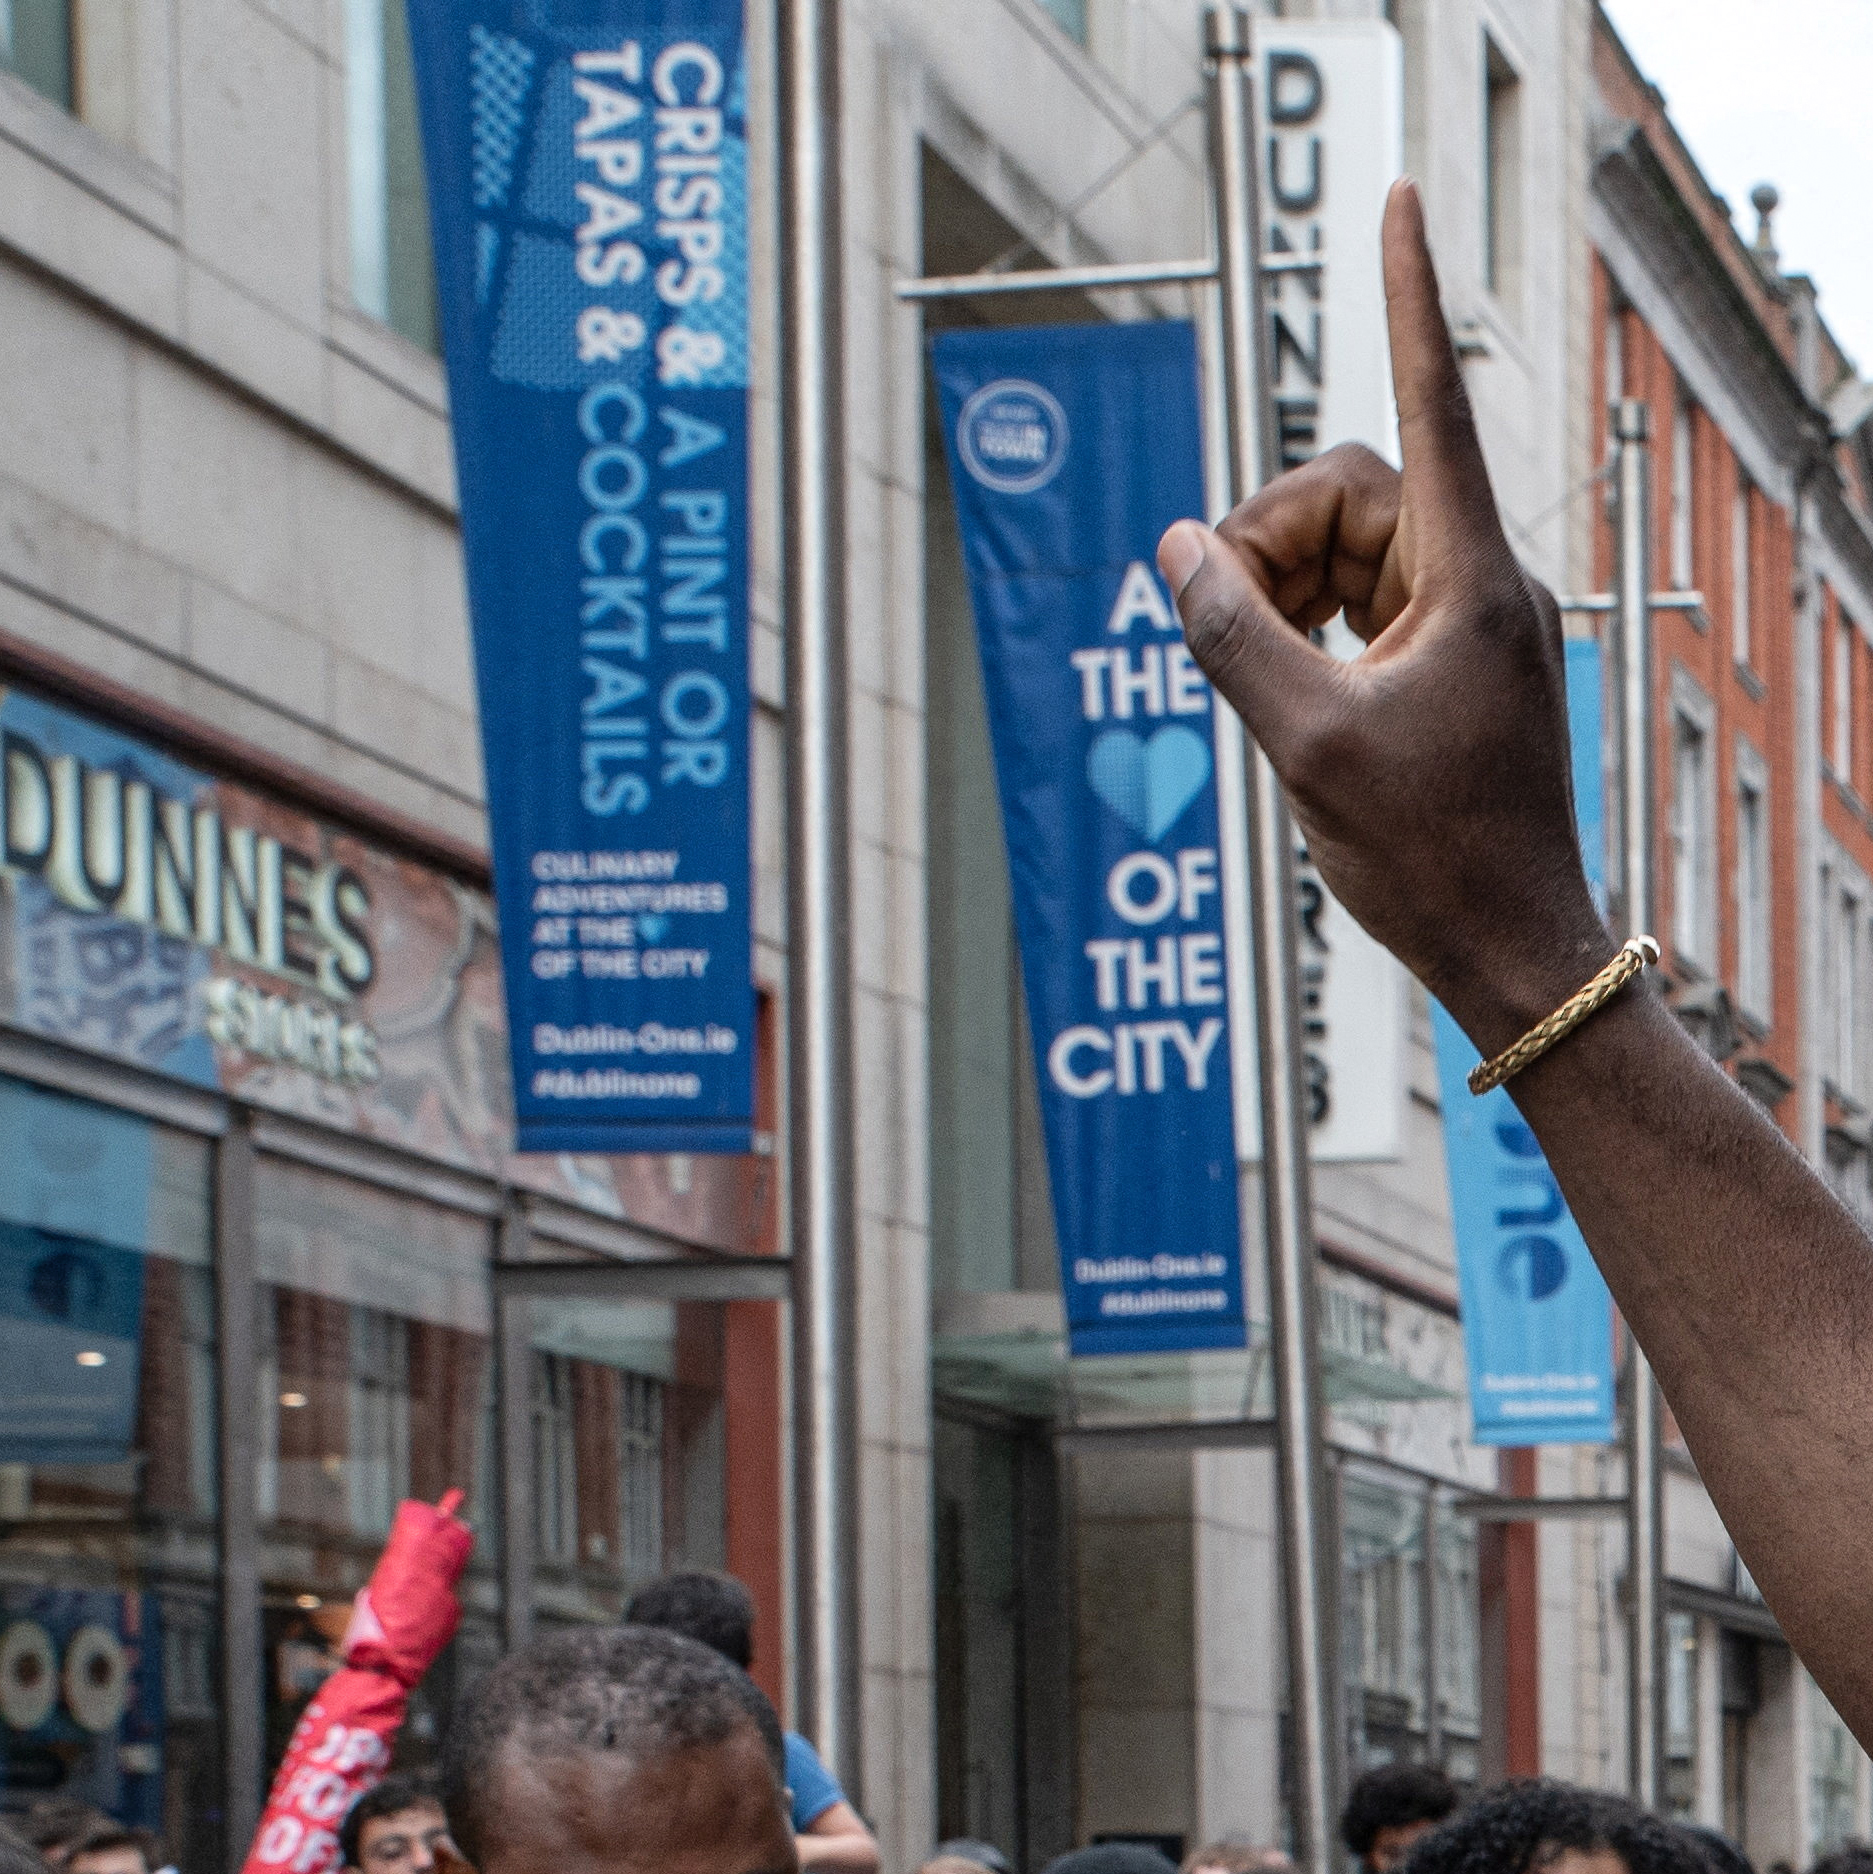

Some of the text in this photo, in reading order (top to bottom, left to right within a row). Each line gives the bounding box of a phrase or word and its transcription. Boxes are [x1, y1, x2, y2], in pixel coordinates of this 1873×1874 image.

[572, 40, 650, 817] TAPAS & COCKTAILS
[653, 42, 730, 787] CRISPS & A PINT OR
[1070, 643, 1209, 722] THE
[1, 727, 375, 1003] DUNNES
[531, 851, 680, 881] CULINARY
[531, 882, 729, 914] ADVENTURES
[1107, 849, 1218, 927] OF
[531, 949, 710, 979] OF THE CITY
[532, 916, 635, 946] AT THE
[1085, 933, 1224, 1012] THE
[534, 1022, 738, 1055] Dublin-One.ie
[1047, 1018, 1226, 1100] CITY
